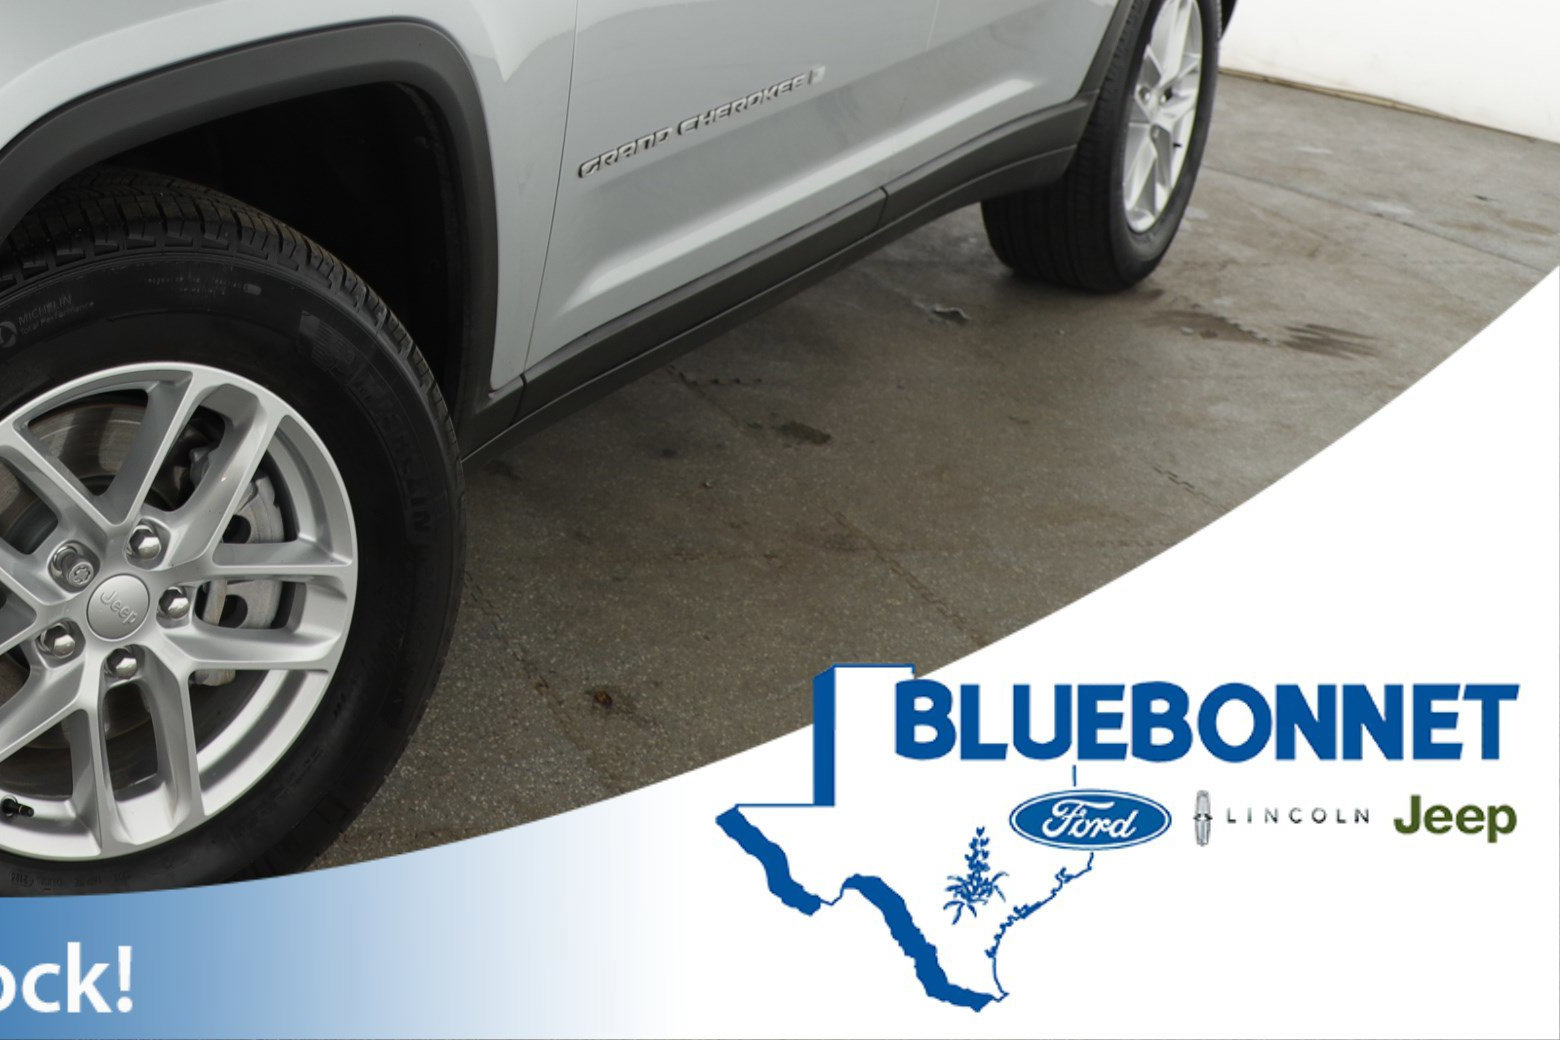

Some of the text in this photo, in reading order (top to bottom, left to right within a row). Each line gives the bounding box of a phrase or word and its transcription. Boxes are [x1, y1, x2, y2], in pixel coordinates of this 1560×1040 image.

[577, 73, 806, 178] GRAND CHEROKEE
[100, 590, 138, 625] Jeep
